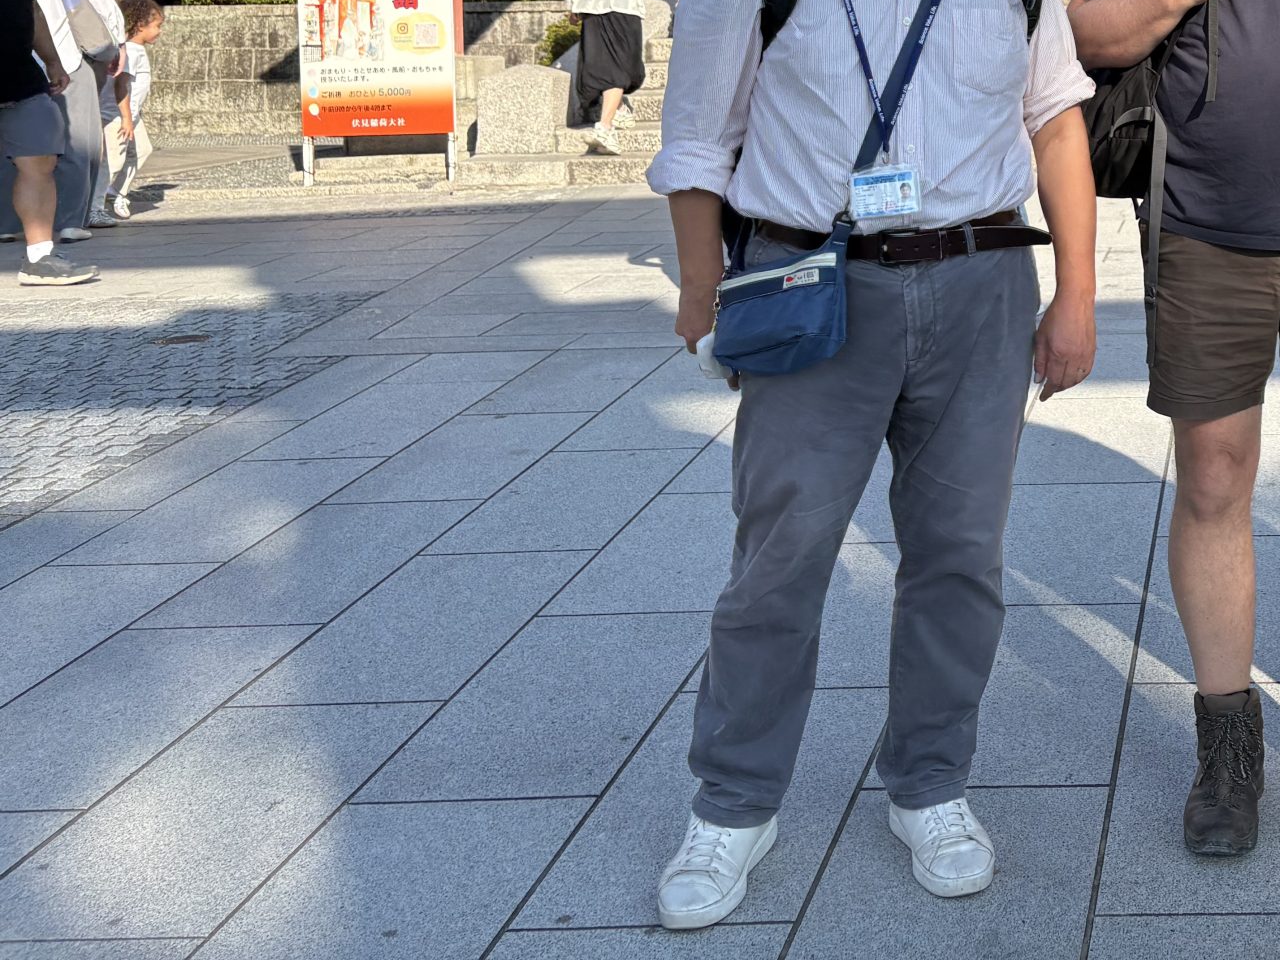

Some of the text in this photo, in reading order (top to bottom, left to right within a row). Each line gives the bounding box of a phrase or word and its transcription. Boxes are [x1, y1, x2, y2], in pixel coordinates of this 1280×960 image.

[352, 117, 406, 128] 伏見稲荷大社
